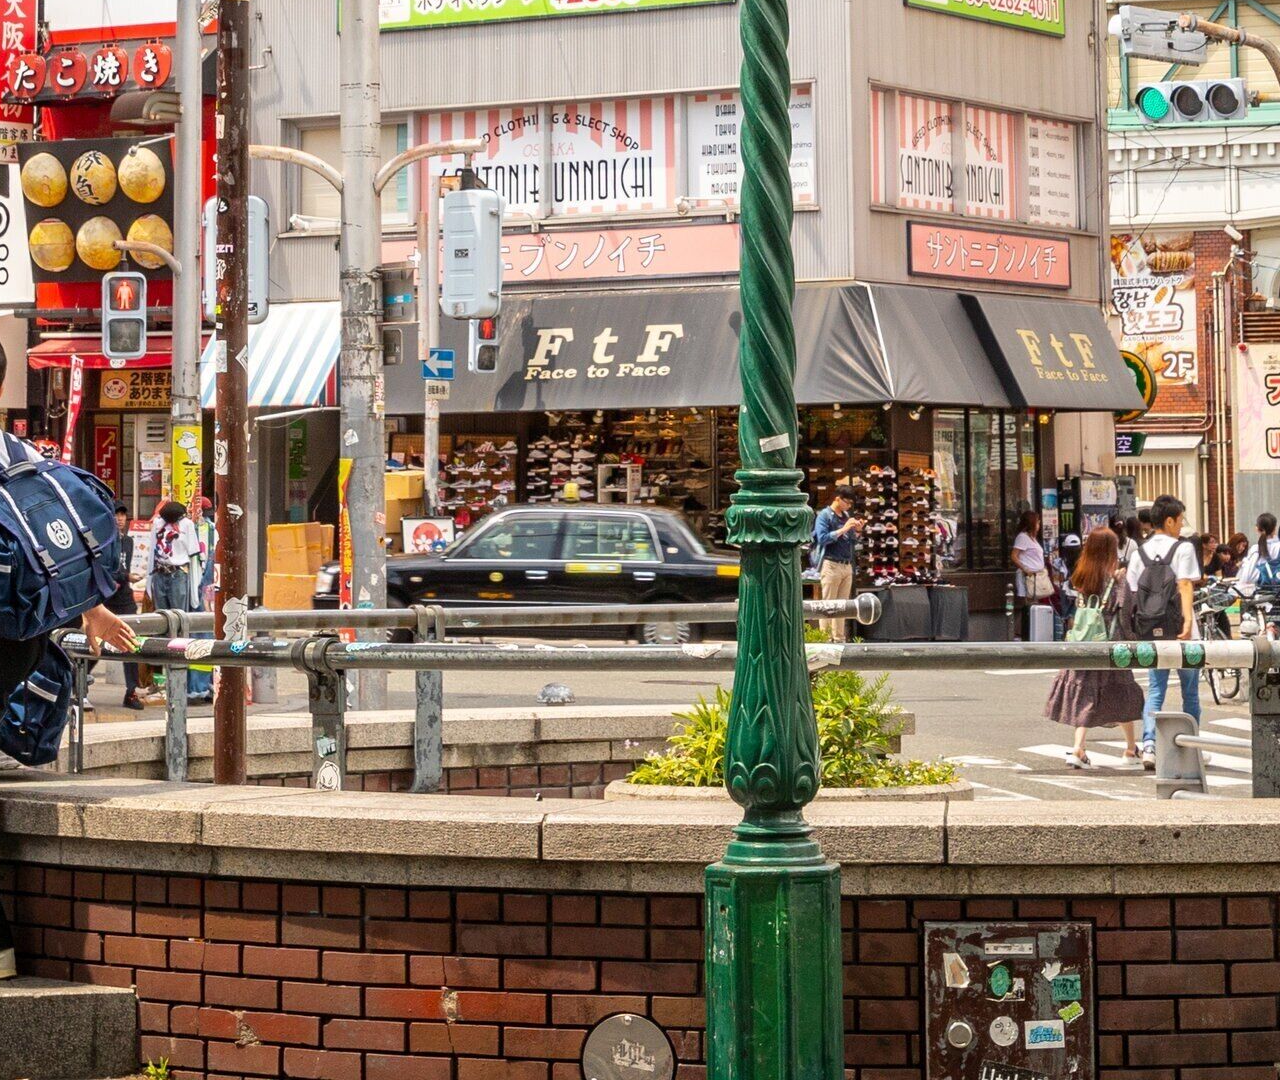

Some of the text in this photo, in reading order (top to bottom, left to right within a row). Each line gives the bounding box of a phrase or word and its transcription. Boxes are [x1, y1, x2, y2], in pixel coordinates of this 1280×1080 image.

[13, 48, 160, 90] たこ焼き
[562, 113, 572, 125] &
[575, 115, 609, 135] SLECT
[609, 125, 640, 152] SHOP
[926, 230, 1057, 279] サントニブンノイチ
[523, 363, 671, 381] Face to Face
[1035, 366, 1109, 383] Face to Face
[1162, 351, 1194, 379] 2F
[1116, 434, 1133, 454] 空
